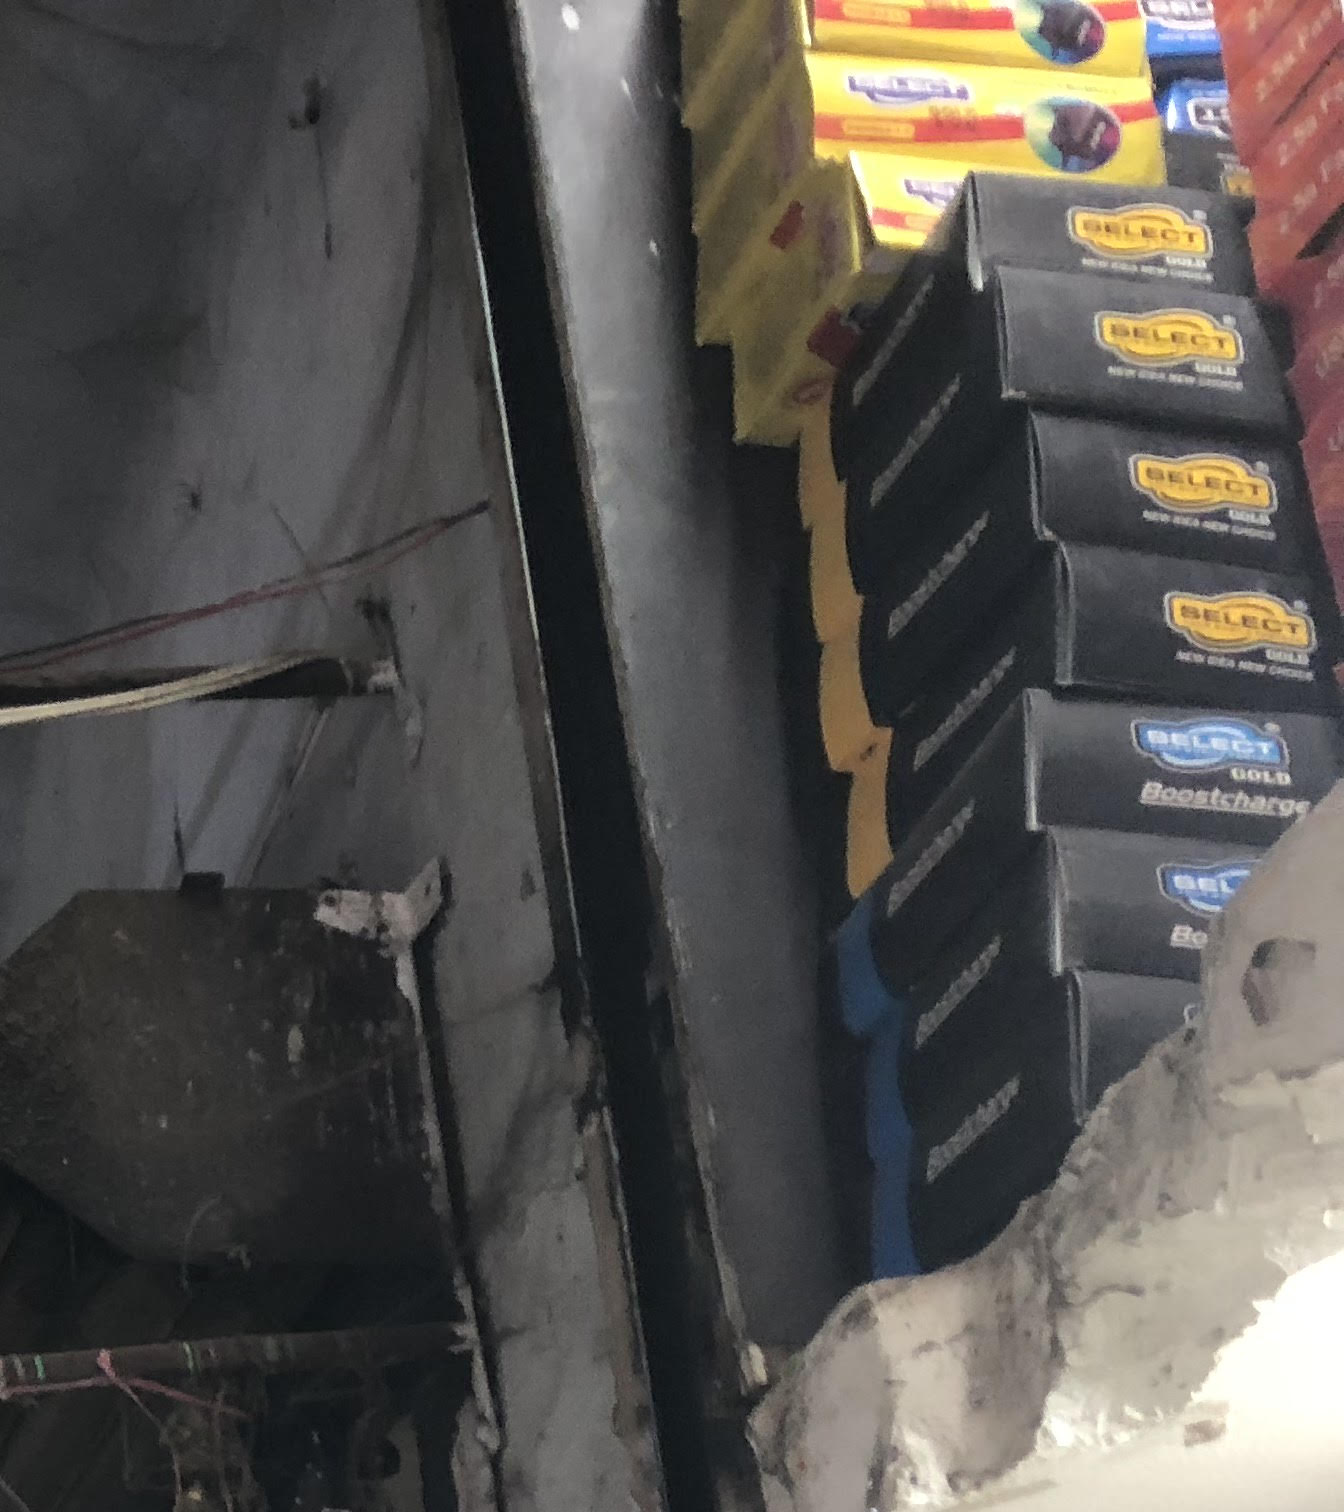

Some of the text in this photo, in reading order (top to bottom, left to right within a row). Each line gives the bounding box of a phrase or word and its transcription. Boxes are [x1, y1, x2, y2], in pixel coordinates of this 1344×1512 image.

[1145, 466, 1266, 497] SELECT
[1180, 604, 1301, 635] SELECT
[1146, 730, 1273, 755] SELECT
[1229, 767, 1292, 786] GOLD
